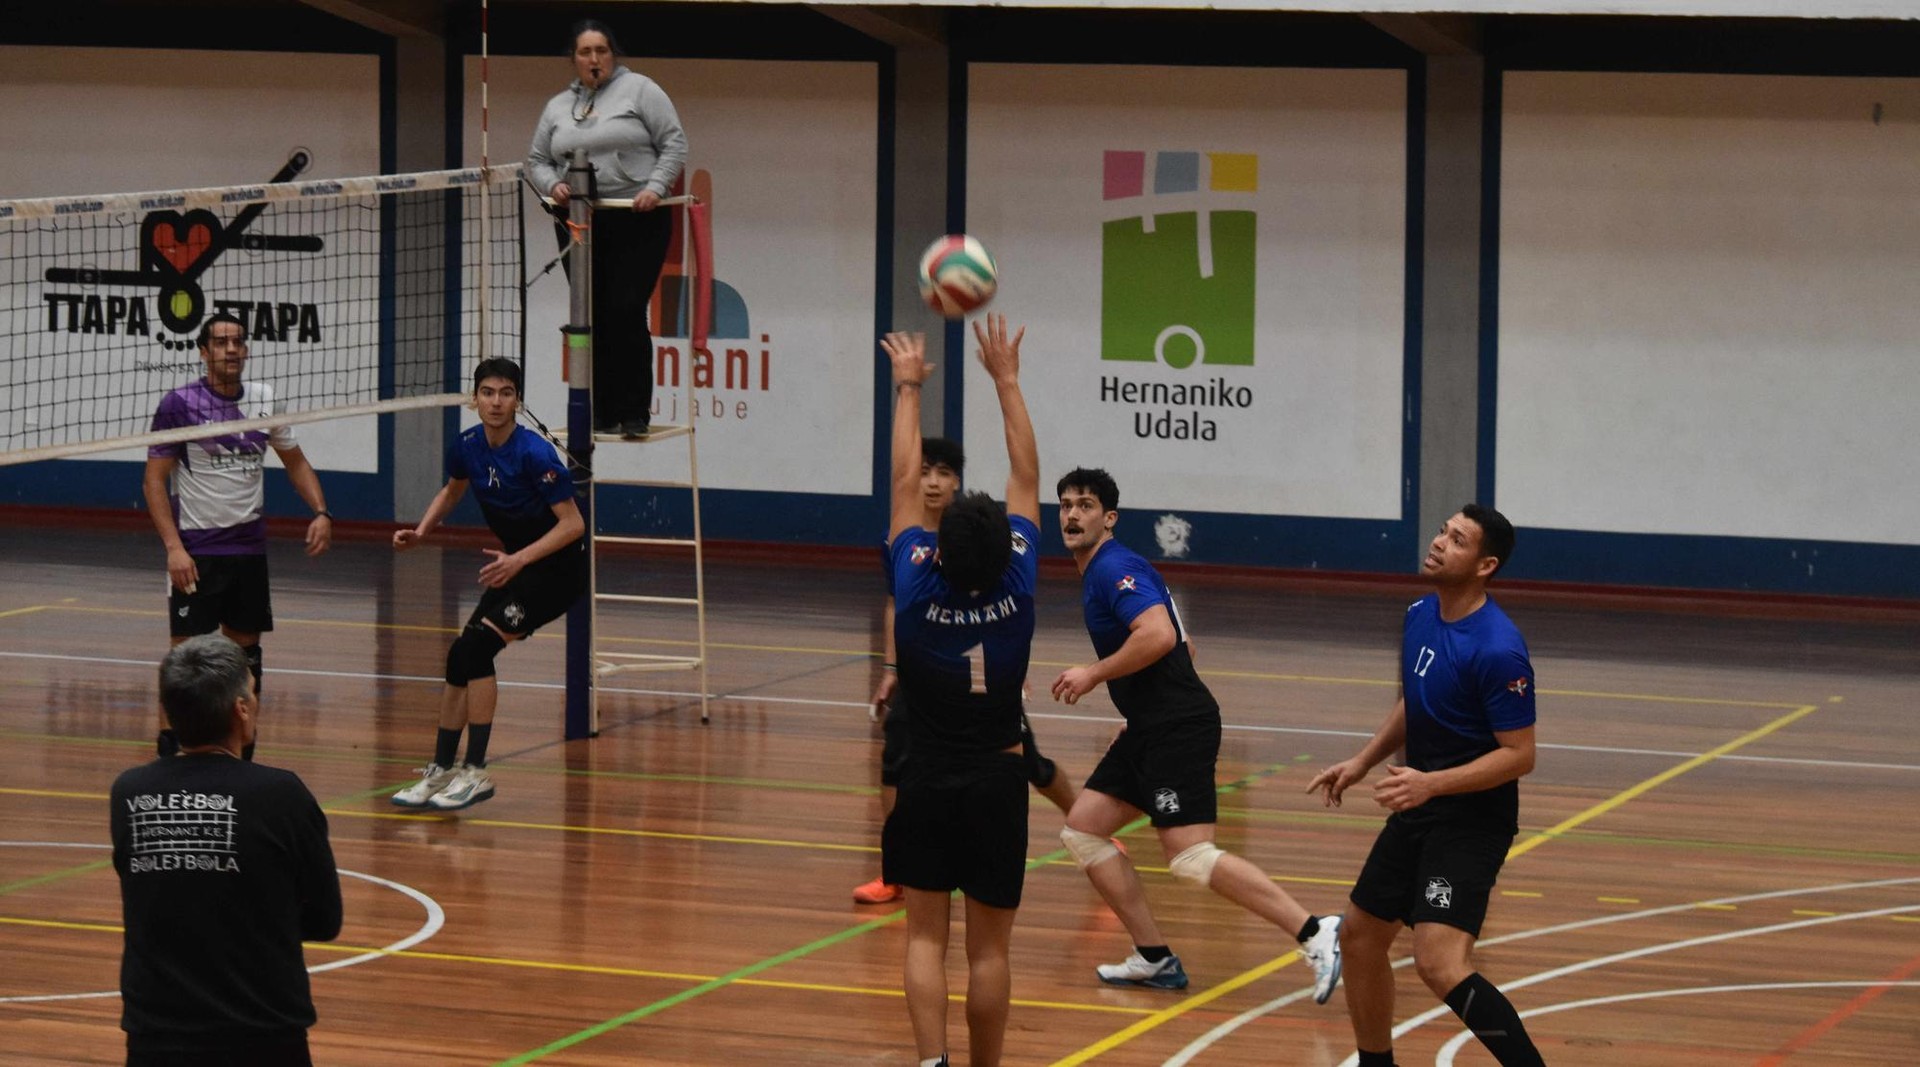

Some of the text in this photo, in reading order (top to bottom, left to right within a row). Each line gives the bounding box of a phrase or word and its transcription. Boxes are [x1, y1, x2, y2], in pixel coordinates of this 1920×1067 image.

[44, 293, 149, 336] TTAPA
[1100, 376, 1253, 408] Hernaniko
[1134, 409, 1218, 441] Udala
[925, 595, 1019, 626] HERNANI
[961, 641, 988, 694] 1
[1414, 645, 1436, 678] 17
